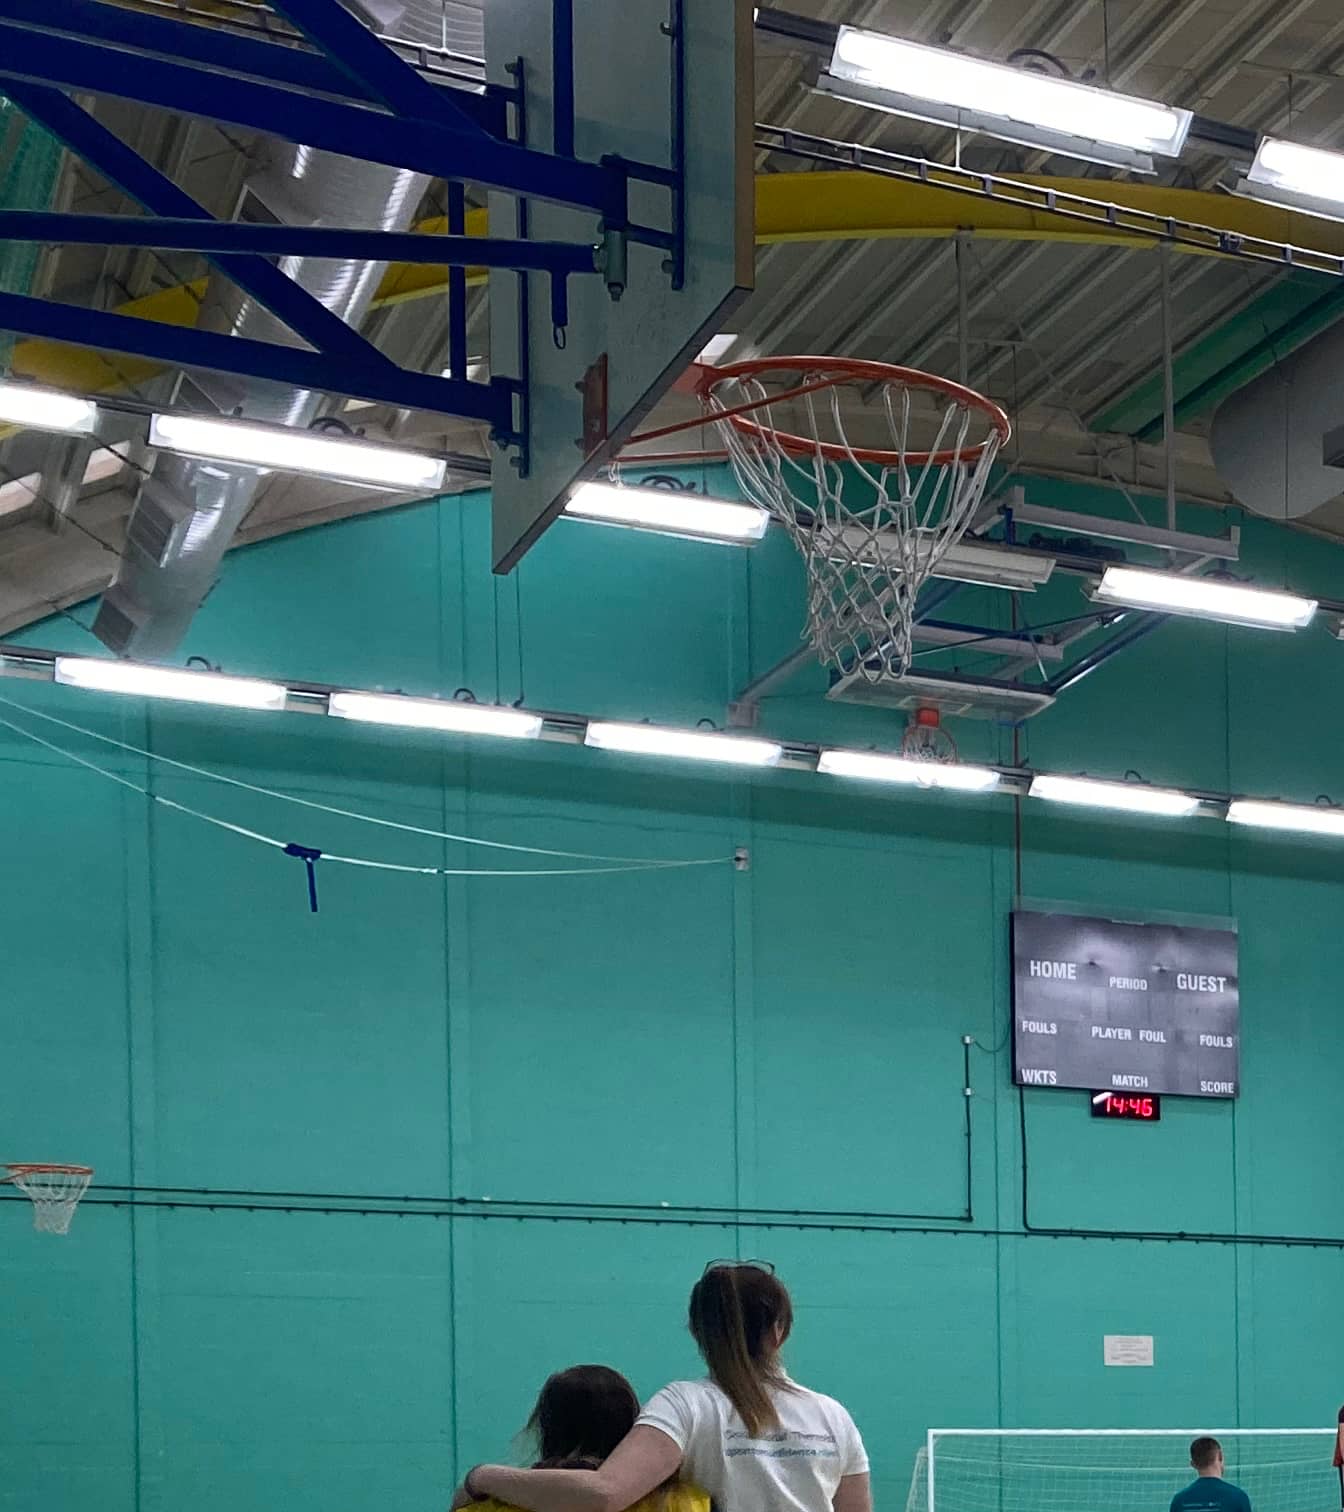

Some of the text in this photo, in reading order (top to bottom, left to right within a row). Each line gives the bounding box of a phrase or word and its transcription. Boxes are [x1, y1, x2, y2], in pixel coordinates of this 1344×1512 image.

[1030, 959, 1077, 980] HOME
[1109, 976, 1148, 991] PERIOD
[1176, 973, 1227, 993] GUEST
[1022, 1020, 1057, 1034] FOULS
[1091, 1026, 1166, 1043] PLAYER FOUL
[1200, 1034, 1233, 1048] FOULS
[1021, 1068, 1057, 1084] WKTS
[1112, 1074, 1148, 1088] MATCH
[1200, 1081, 1234, 1094] SCORE
[1106, 1096, 1153, 1117] 14:46
